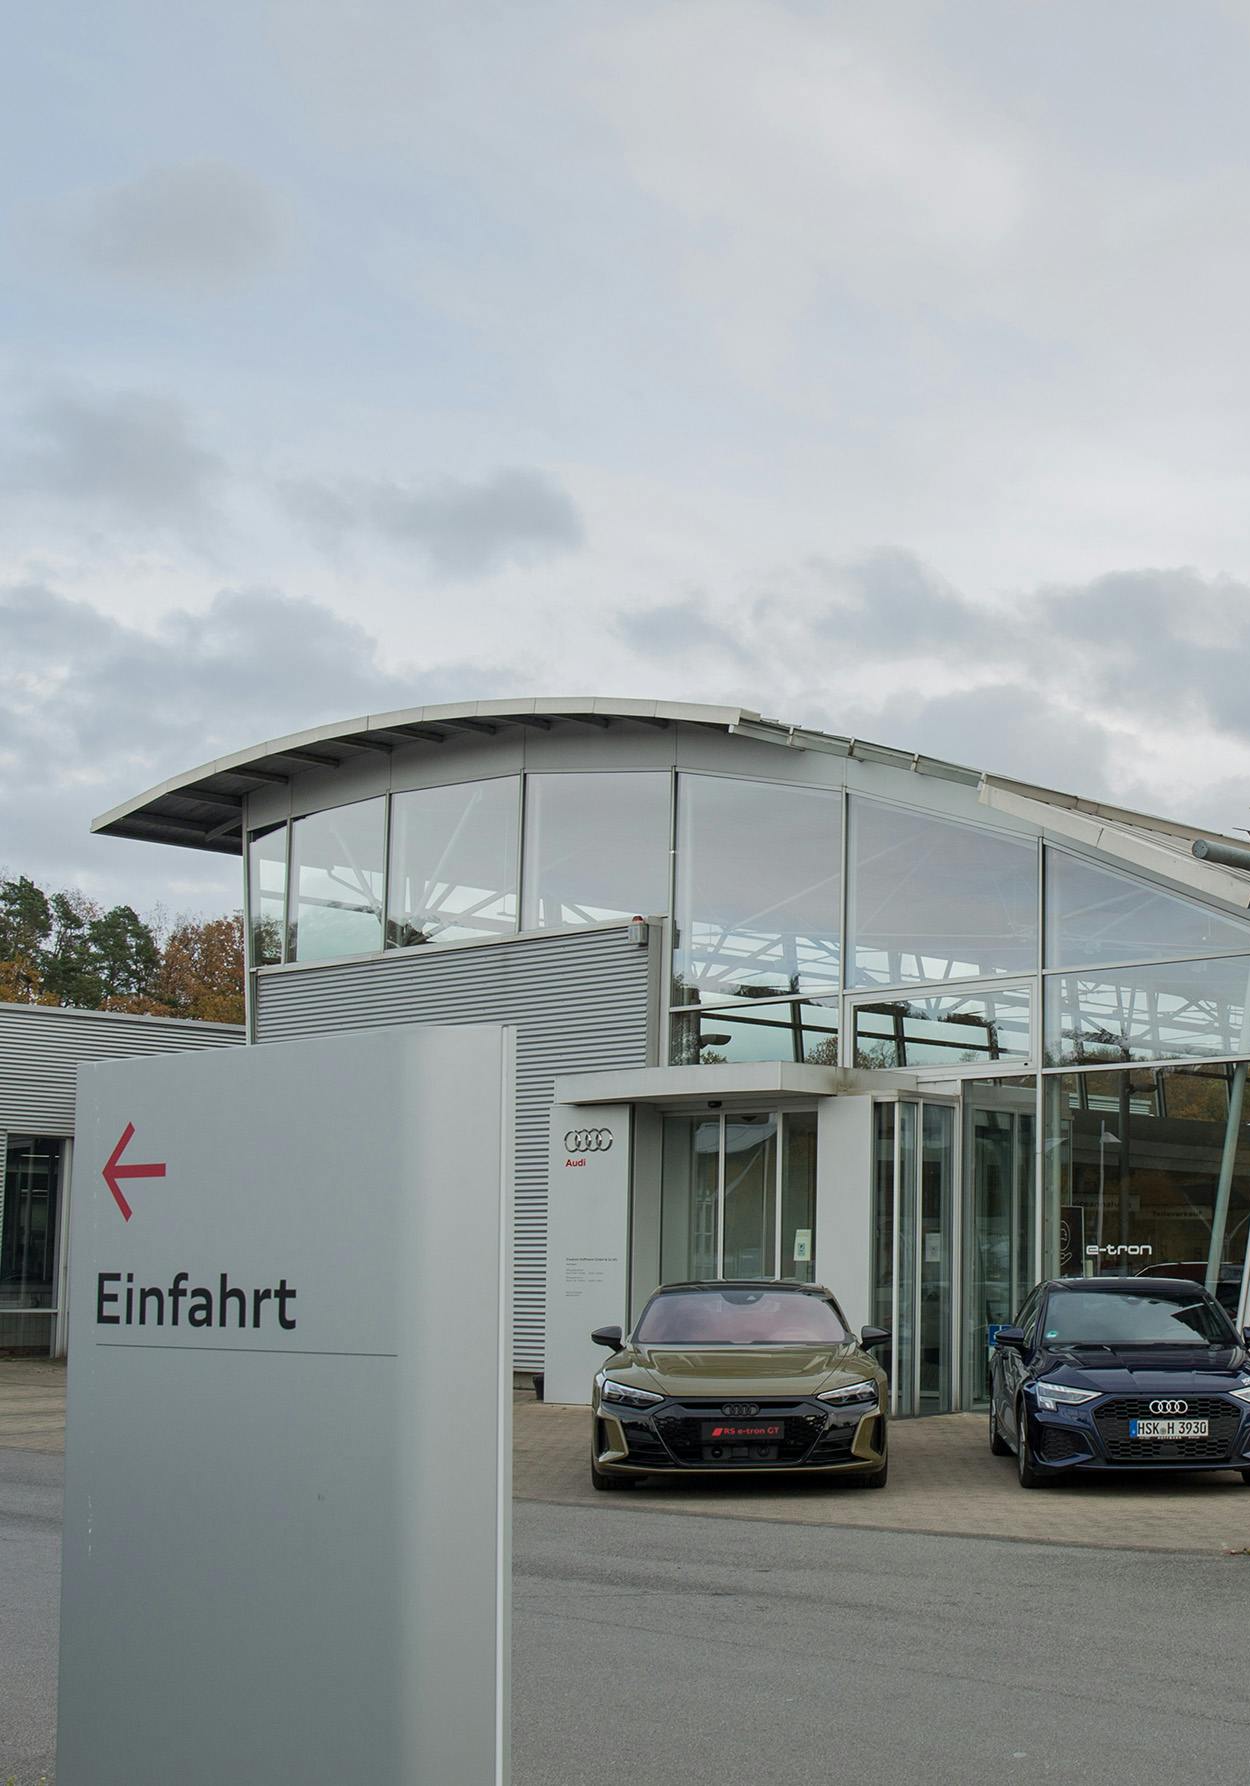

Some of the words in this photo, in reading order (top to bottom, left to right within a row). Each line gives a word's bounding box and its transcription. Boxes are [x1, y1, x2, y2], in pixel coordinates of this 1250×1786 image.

[565, 1159, 587, 1168] Audi
[1086, 1244, 1152, 1255] e-tron
[96, 1272, 297, 1331] Einfahrt
[723, 1427, 735, 1435] RS
[737, 1427, 765, 1435] e-tron
[767, 1426, 780, 1435] GT
[1138, 1422, 1160, 1435] HSK
[1168, 1422, 1175, 1434] H
[1179, 1422, 1207, 1434] 3930
